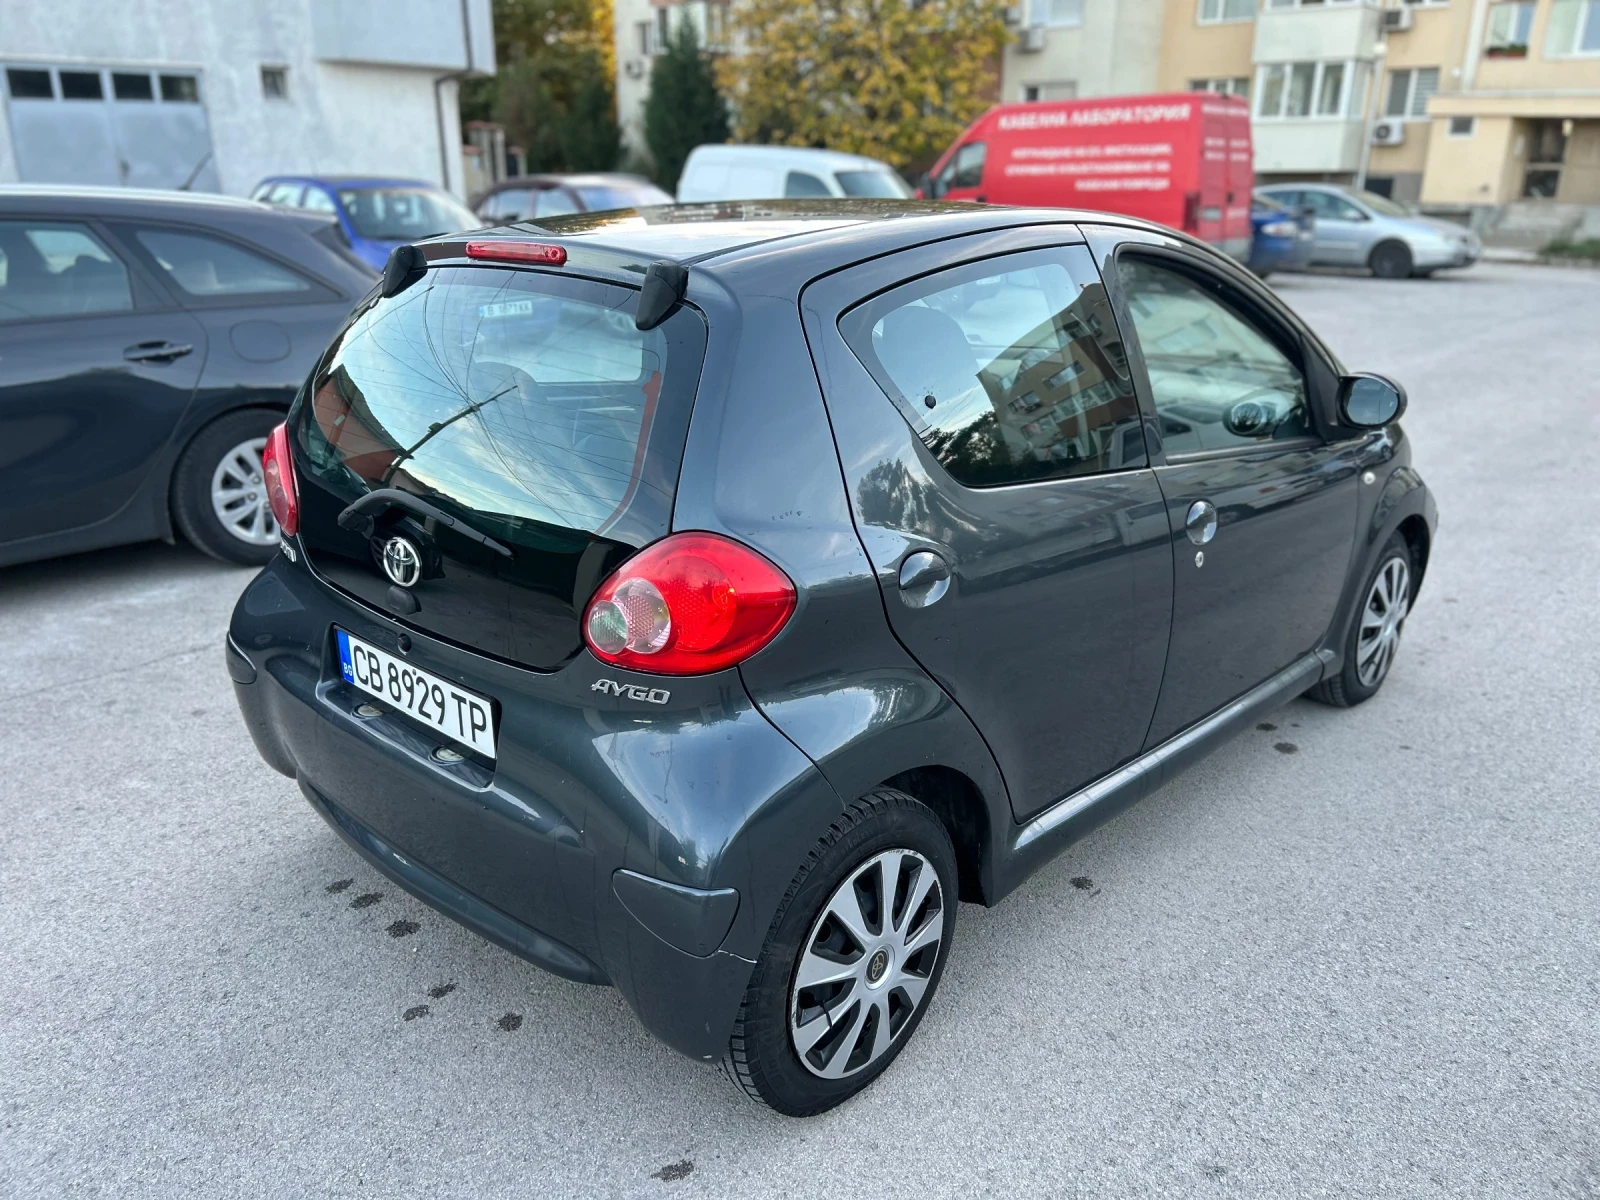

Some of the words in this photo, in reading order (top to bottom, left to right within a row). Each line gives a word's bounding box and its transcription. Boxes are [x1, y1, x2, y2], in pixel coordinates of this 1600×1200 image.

[343, 662, 353, 677] BG
[353, 645, 384, 693] CB
[387, 662, 446, 726] 8929
[450, 691, 487, 743] TP
[591, 678, 671, 705] AYGO
